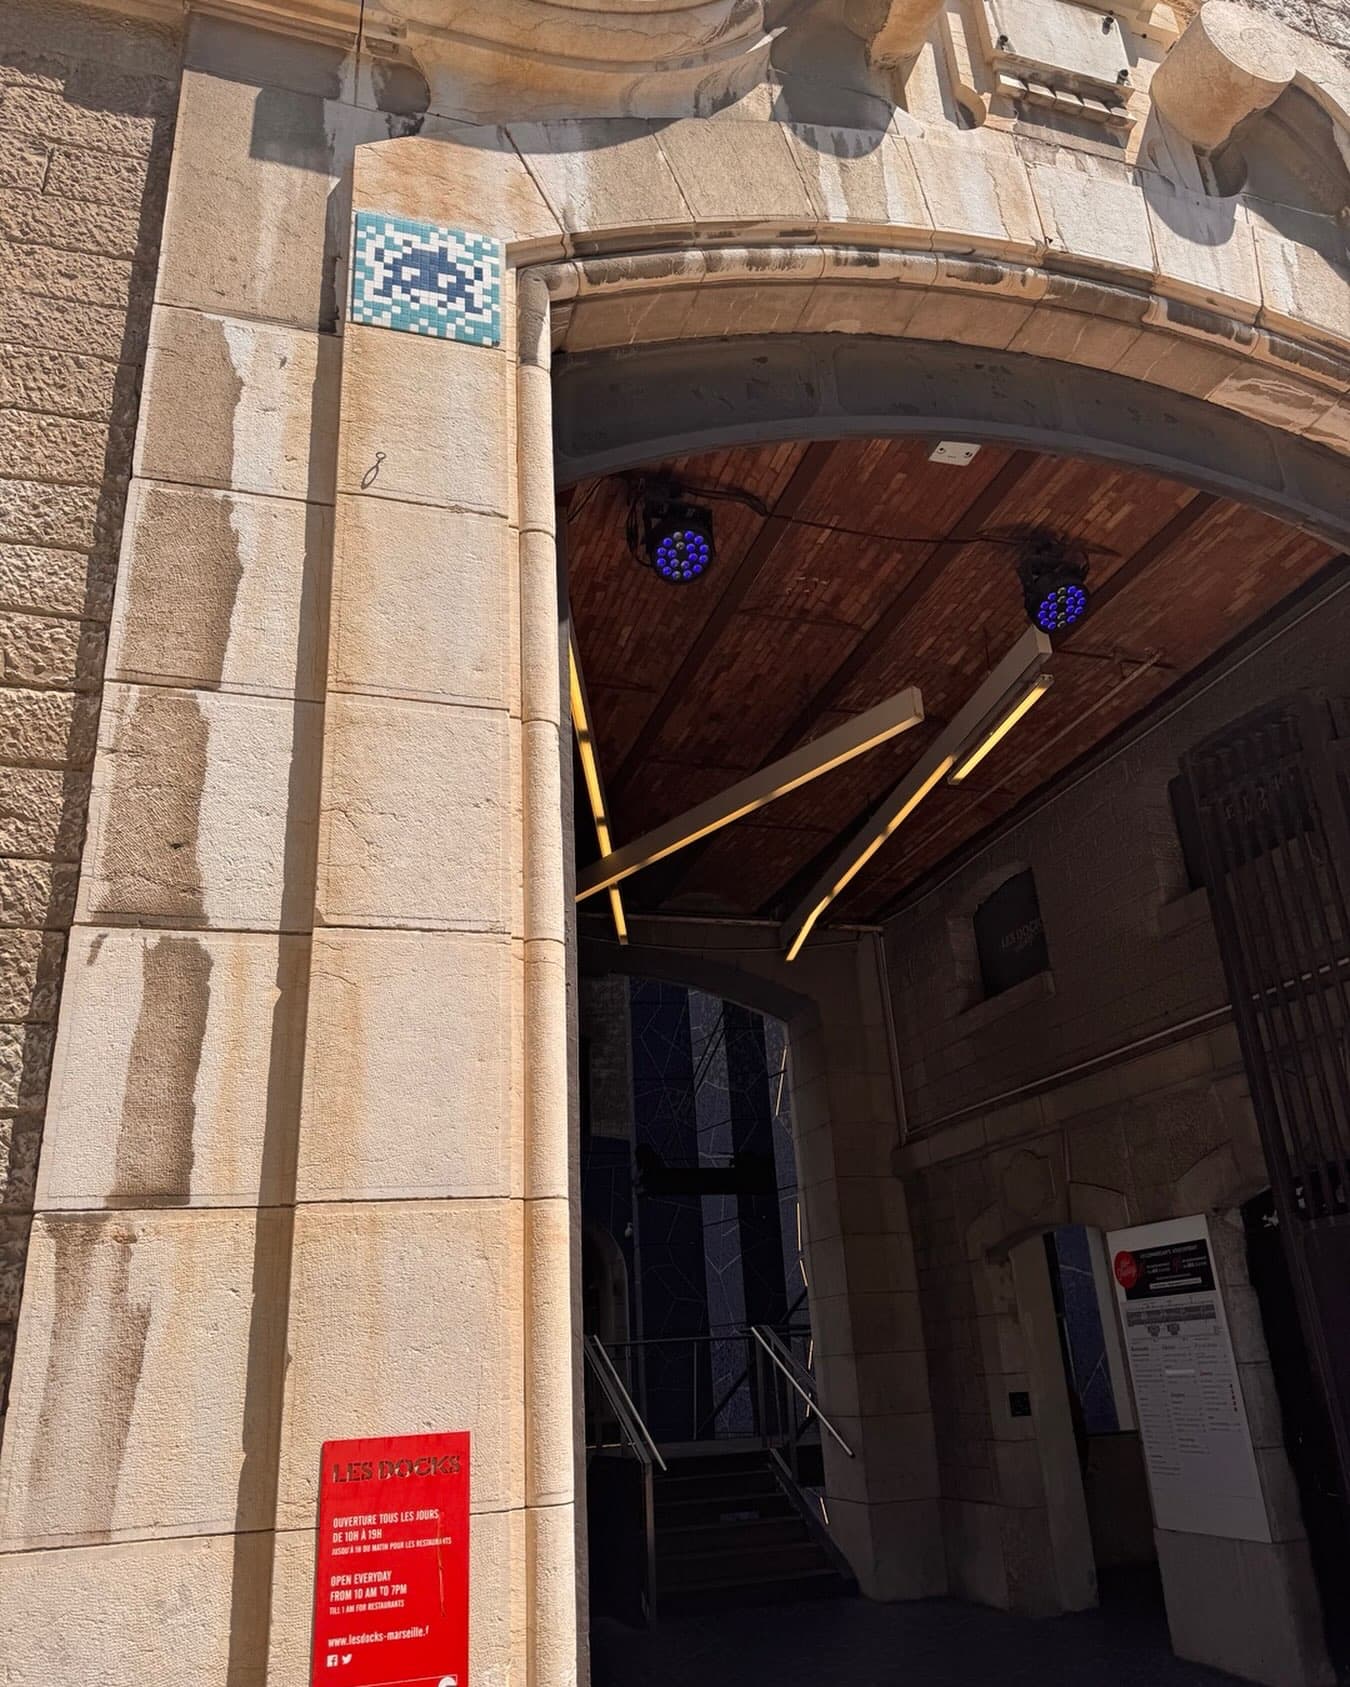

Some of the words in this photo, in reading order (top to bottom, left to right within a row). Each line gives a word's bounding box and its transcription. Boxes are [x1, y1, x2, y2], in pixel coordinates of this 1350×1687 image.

[332, 1462, 373, 1483] LES
[378, 1455, 461, 1480] DOCKS
[333, 1514, 377, 1528] OUVERTURE
[379, 1512, 398, 1524] TOUS
[400, 1511, 414, 1522] LES
[415, 1509, 440, 1521] JOURS
[332, 1532, 343, 1543] DE
[344, 1530, 359, 1542] 10H
[360, 1528, 367, 1540] À
[368, 1528, 383, 1540] 19H
[372, 1543, 389, 1552] MATIN
[389, 1541, 405, 1550] POUR
[405, 1540, 415, 1548] LES
[330, 1574, 351, 1587] OPEN
[353, 1570, 393, 1585] EVERYDAY
[330, 1590, 352, 1602] FROM
[354, 1588, 364, 1599] 10
[365, 1587, 377, 1598] AM
[379, 1585, 389, 1597] TO
[391, 1583, 407, 1596] 7PM
[329, 1605, 340, 1616] TILL
[341, 1605, 345, 1614] 1
[345, 1604, 355, 1613] AM
[355, 1602, 367, 1612] FOR
[367, 1599, 405, 1611] RESTAURANTS
